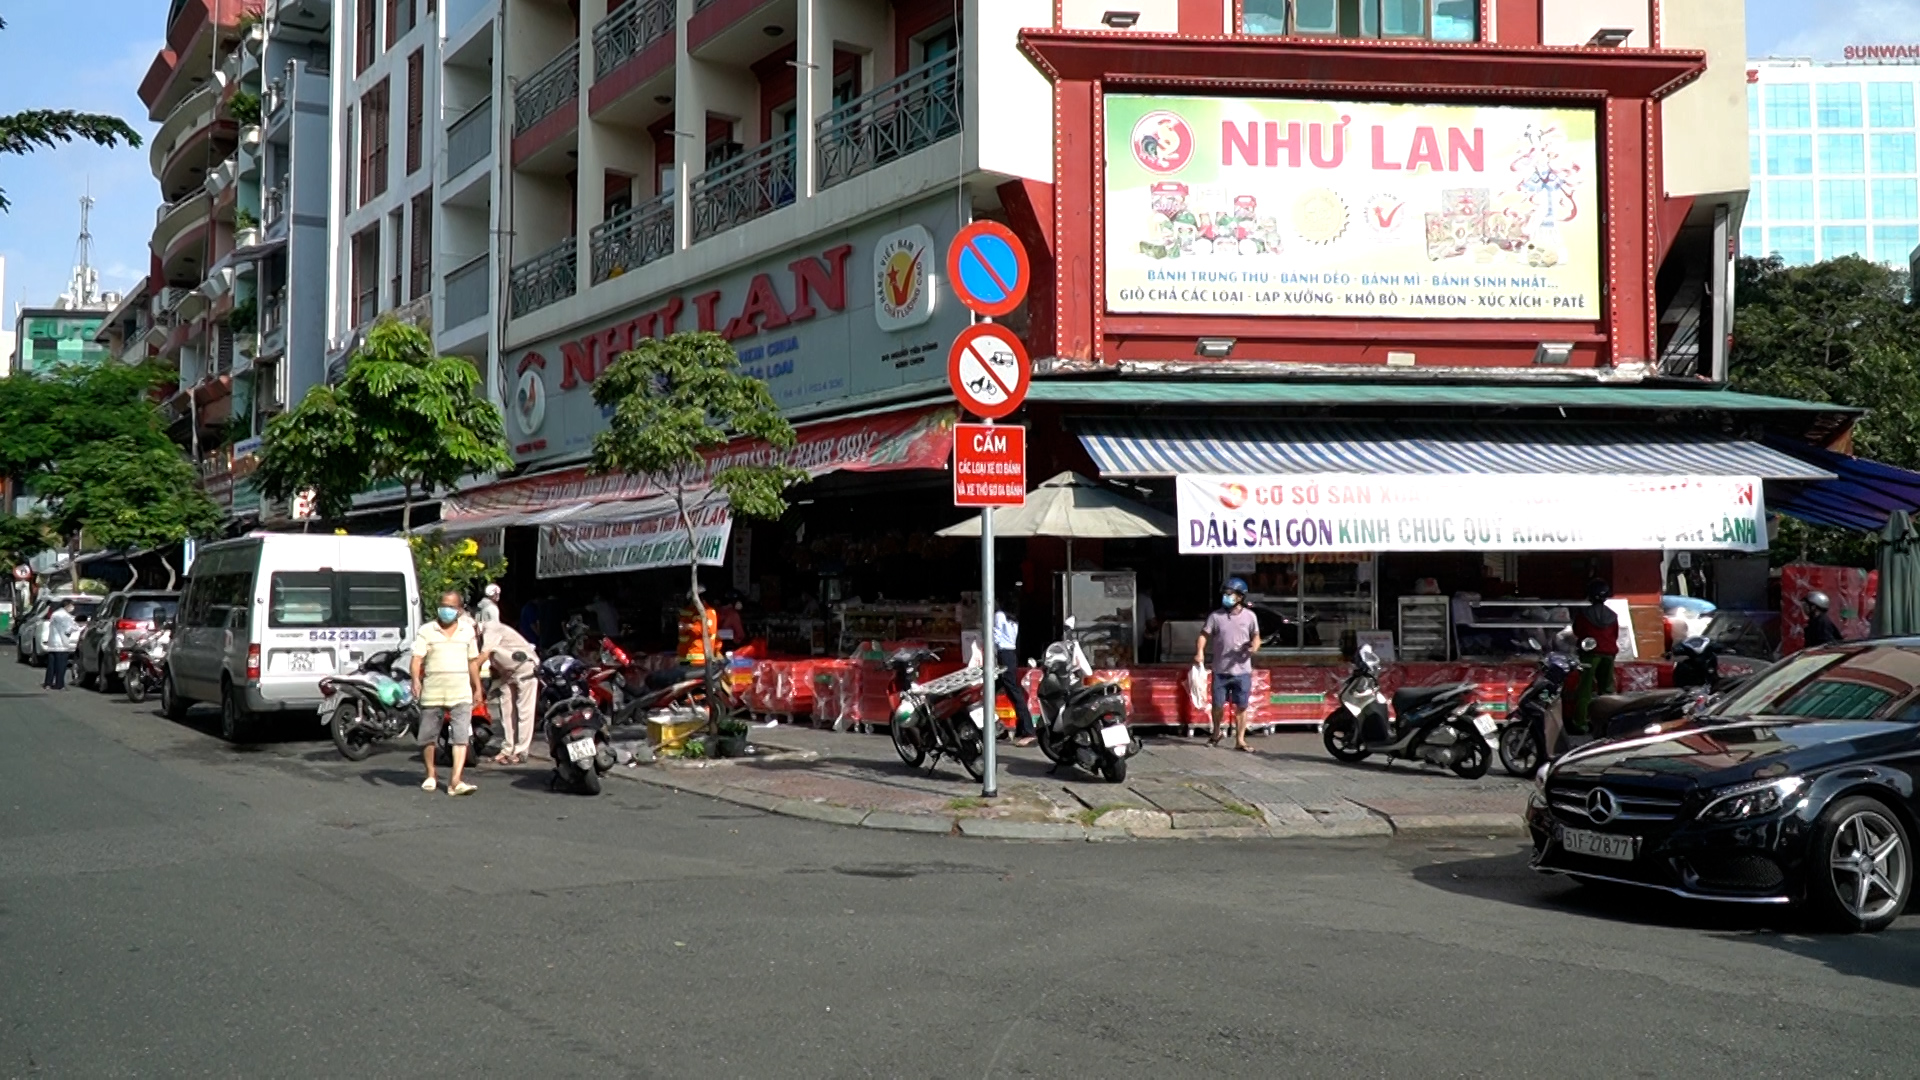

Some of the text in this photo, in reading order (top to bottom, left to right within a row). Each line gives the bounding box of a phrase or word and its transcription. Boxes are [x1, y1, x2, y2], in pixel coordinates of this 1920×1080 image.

[1843, 45, 1919, 60] SUNWAH
[1221, 114, 1485, 173] NHƯ LAN
[1147, 267, 1187, 282] BÁNH
[1191, 270, 1238, 283] TRUNG
[1241, 270, 1269, 283] THU
[1280, 270, 1319, 284] BÁNH
[1361, 271, 1400, 286] BÁNH
[1403, 272, 1420, 286] MÌ
[1432, 272, 1470, 287] BÁNH
[1474, 275, 1507, 288] SINH
[693, 243, 852, 342] LAN
[1119, 286, 1145, 301] GIÒ
[1149, 286, 1178, 301] CHẢ
[1181, 286, 1209, 302] CÁC
[1212, 290, 1244, 305] LOẠI
[1255, 292, 1281, 306] LẠP
[1345, 290, 1375, 305] KHÔ
[1379, 290, 1398, 305] BÒ
[1409, 294, 1467, 306] JAMBON
[1478, 292, 1506, 307] XÚC
[1509, 291, 1542, 307] XÍCH
[973, 428, 1007, 454] CẤM
[1255, 483, 1284, 506] CƠ
[1291, 478, 1320, 506] SỞ
